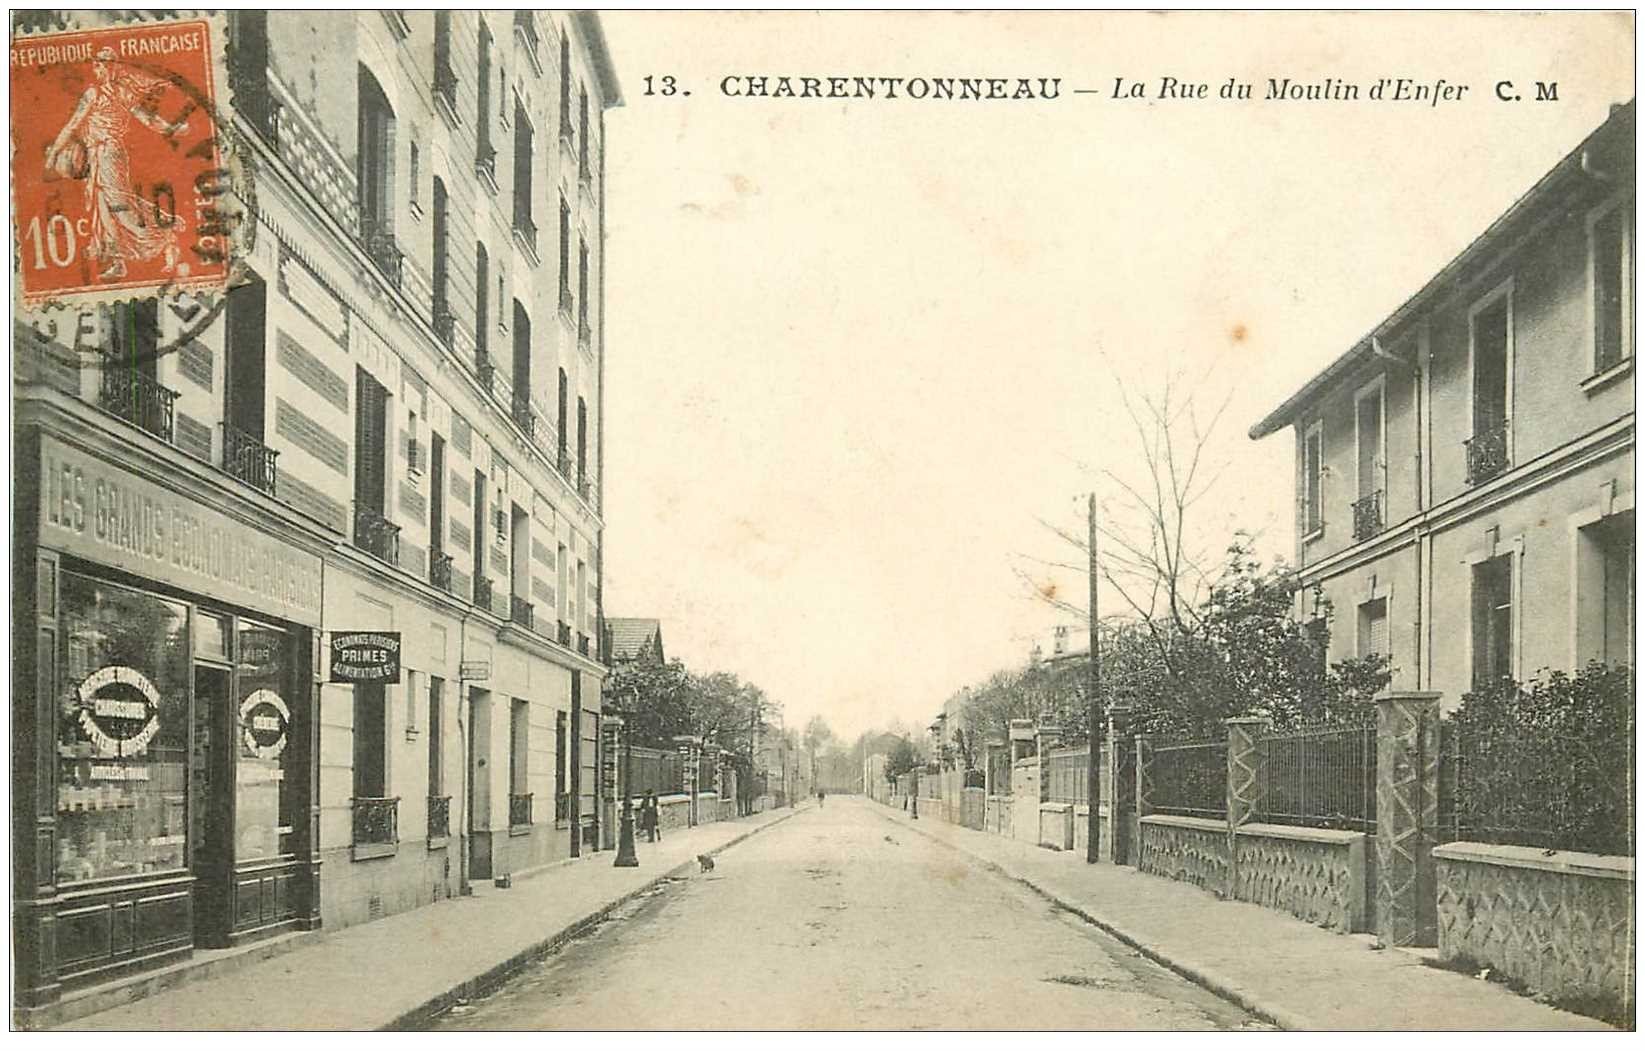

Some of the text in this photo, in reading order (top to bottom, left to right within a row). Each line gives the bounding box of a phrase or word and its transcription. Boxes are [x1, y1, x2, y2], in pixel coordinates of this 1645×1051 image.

[47, 457, 87, 536] LES
[93, 479, 165, 564] GRANDS
[342, 650, 388, 663] PRIMES
[332, 662, 384, 679] ALIMENTATION
